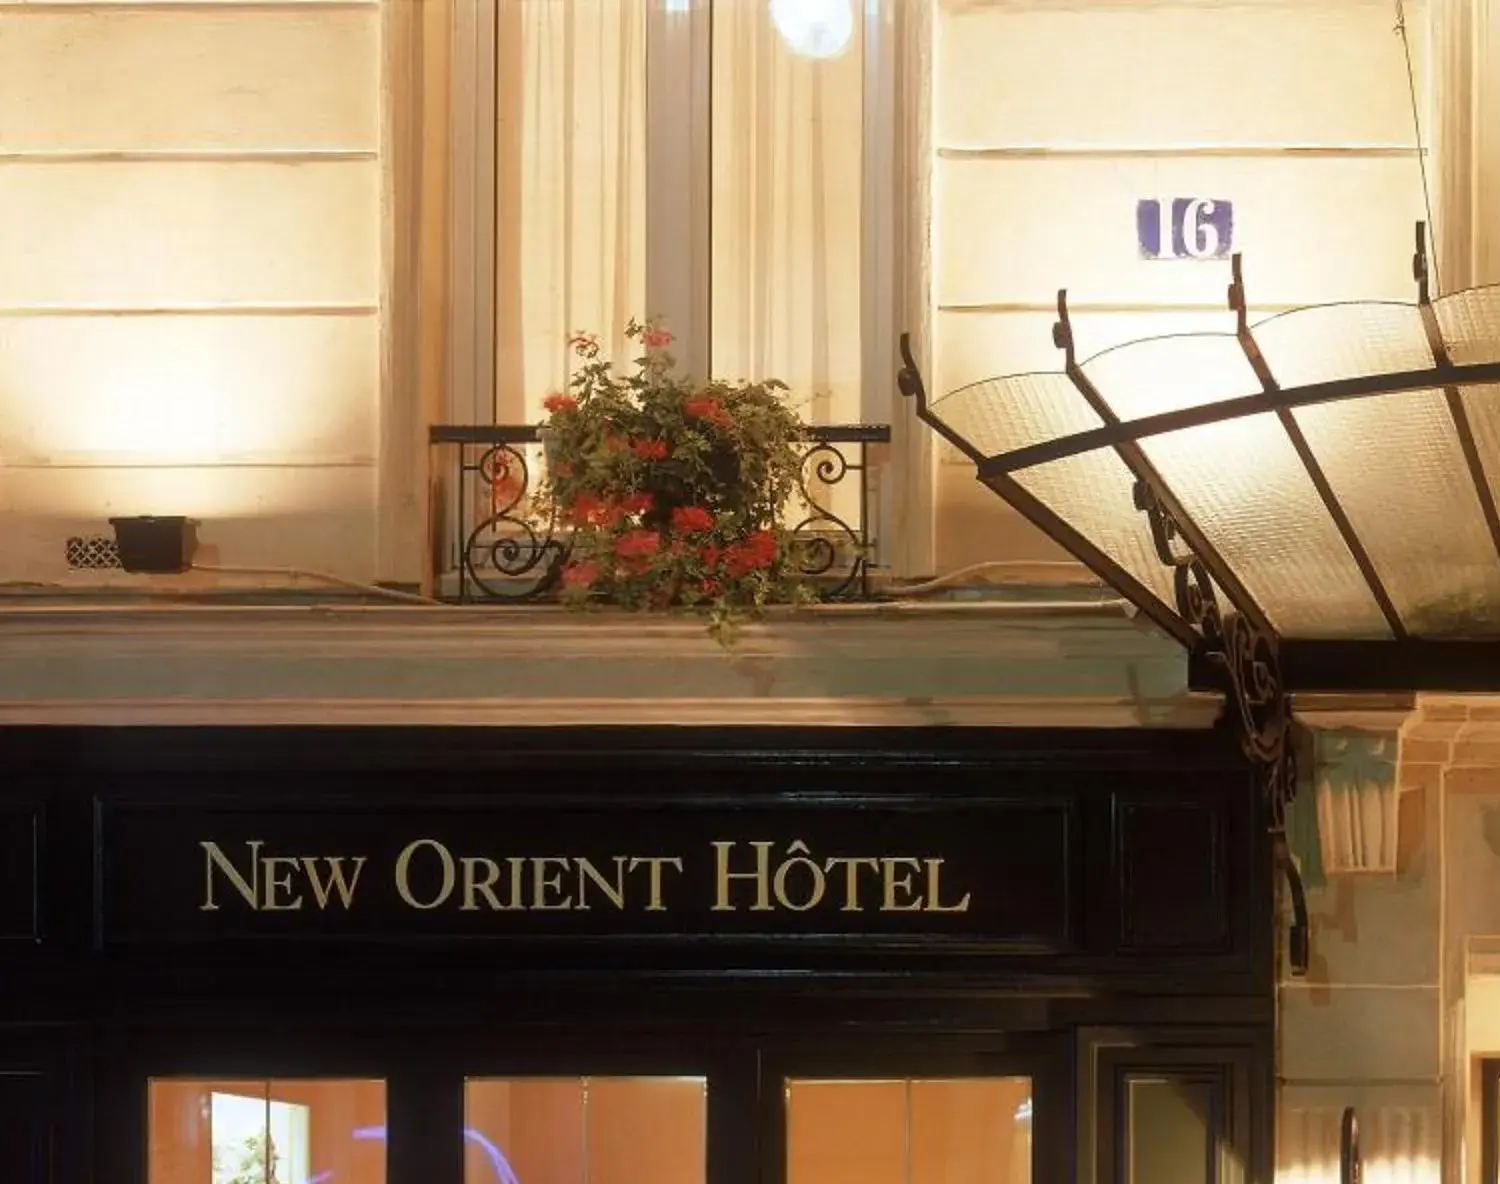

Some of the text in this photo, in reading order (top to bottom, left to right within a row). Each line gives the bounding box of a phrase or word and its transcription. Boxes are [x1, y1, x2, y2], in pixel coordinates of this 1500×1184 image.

[1156, 197, 1220, 260] 16
[199, 839, 972, 911] NEW ORIENT HÔTEL
